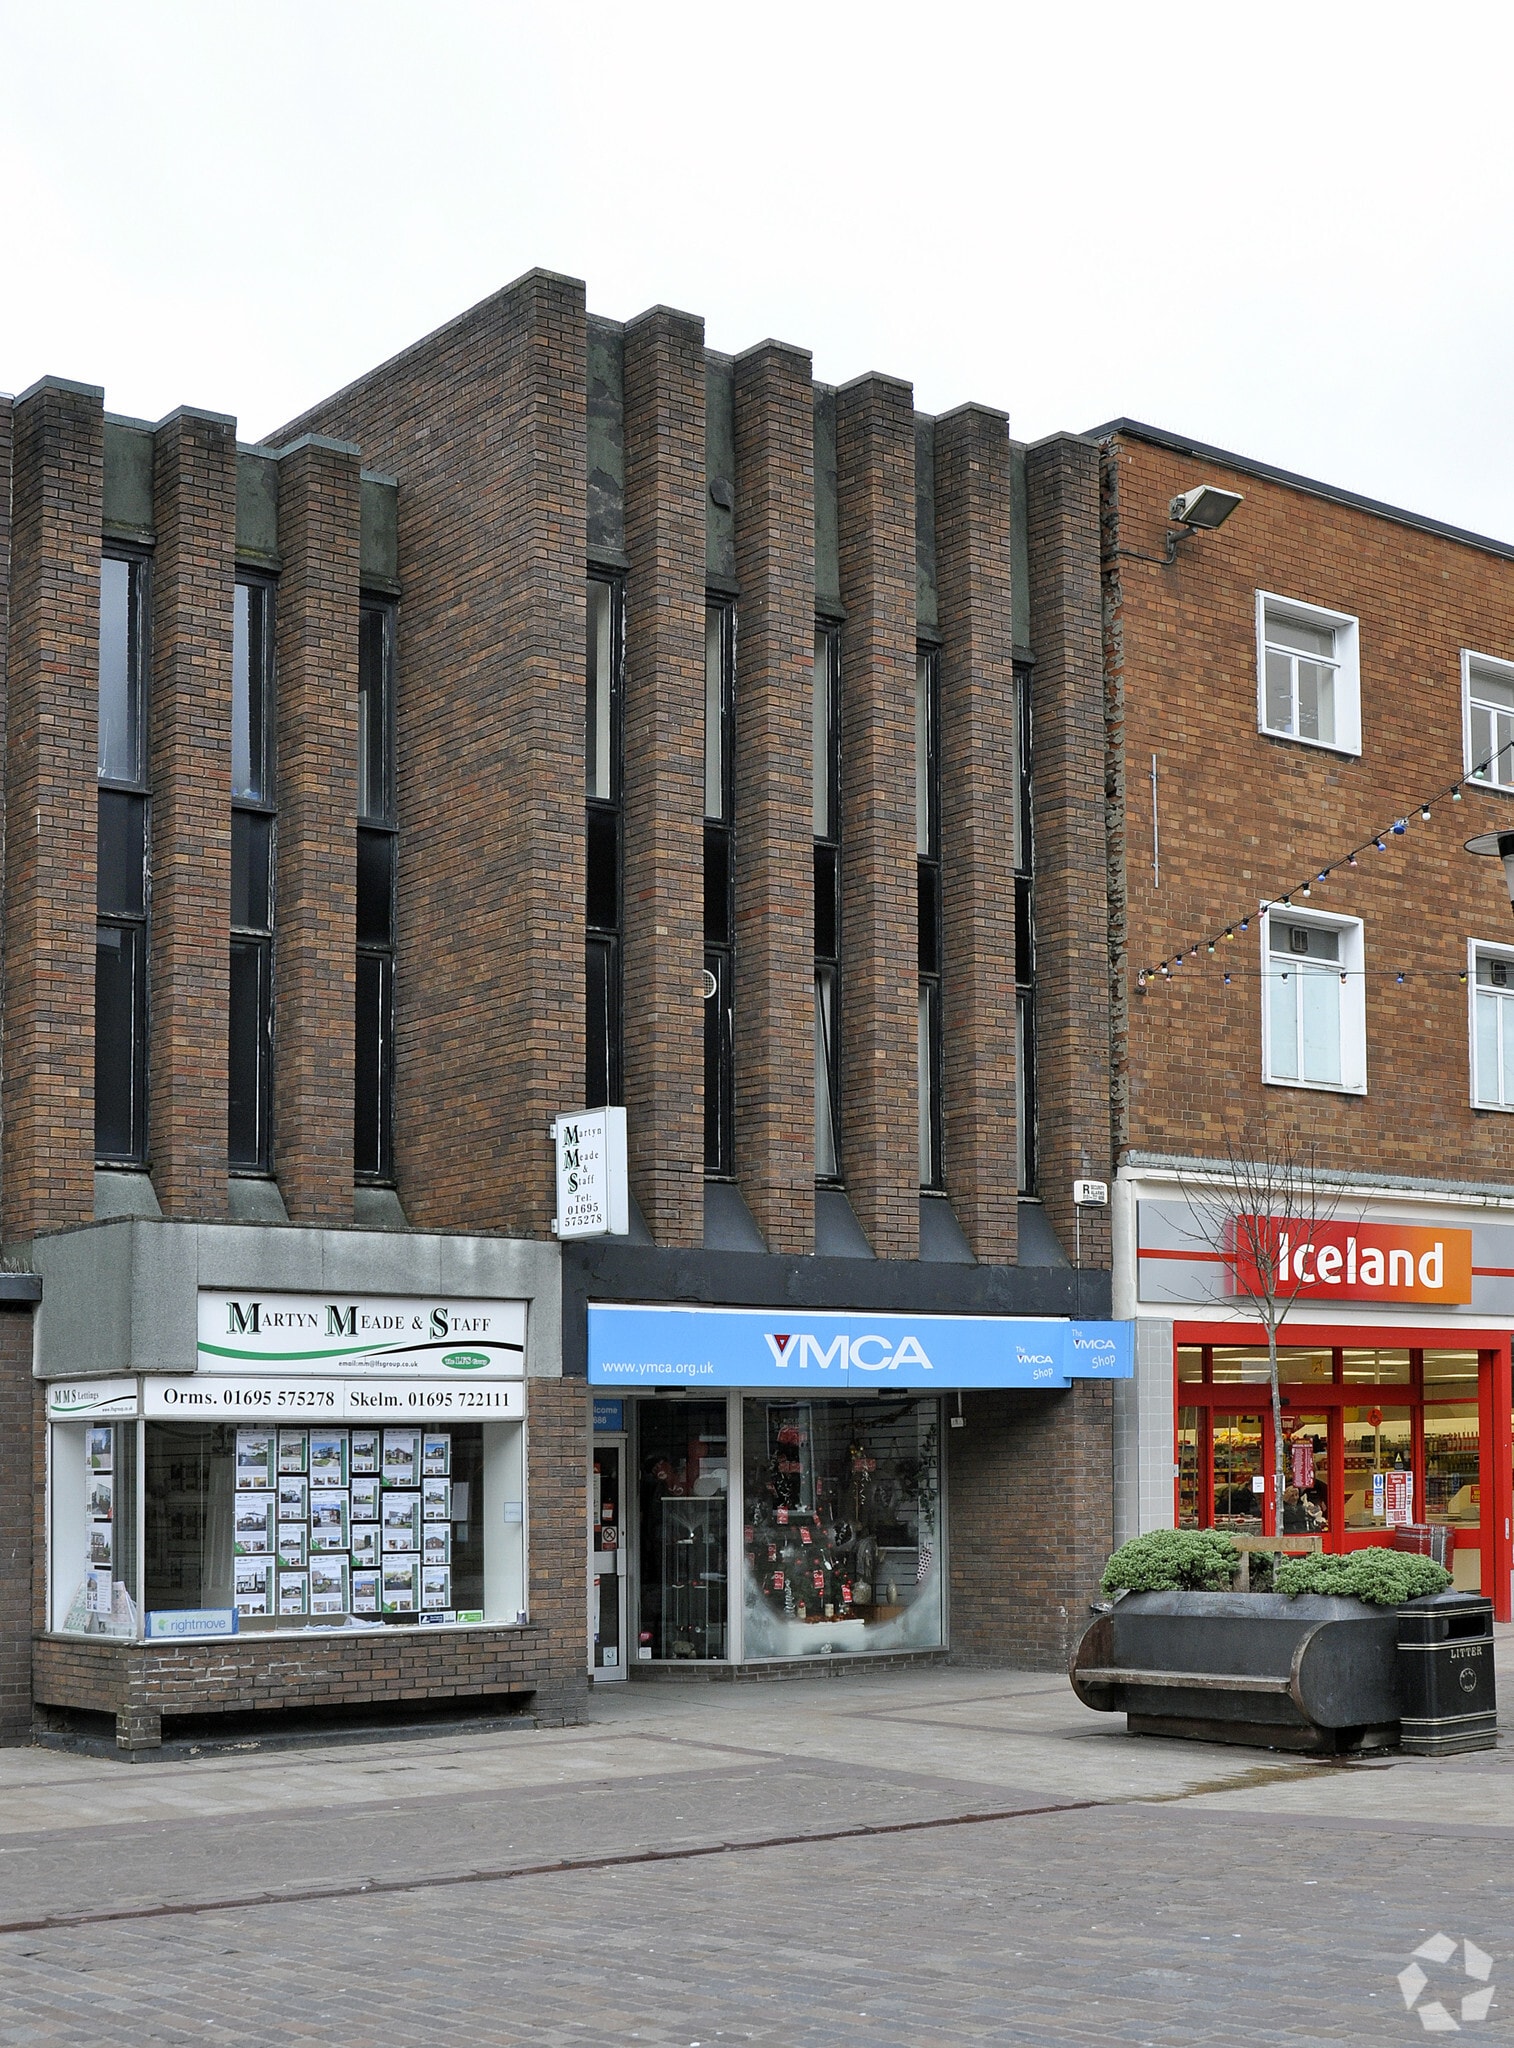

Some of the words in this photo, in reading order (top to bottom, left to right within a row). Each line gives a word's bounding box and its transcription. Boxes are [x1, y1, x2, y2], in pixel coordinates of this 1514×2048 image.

[562, 1125, 602, 1148] Martyn
[562, 1148, 599, 1171] Meade
[582, 1164, 588, 1173] &
[567, 1172, 594, 1195] Staff
[1082, 1184, 1090, 1194] R
[575, 1194, 592, 1203] Tel:
[567, 1202, 599, 1216] 01695
[564, 1213, 602, 1228] 575278
[1279, 1232, 1444, 1289] Iceland
[411, 1315, 423, 1330] &
[1072, 1329, 1083, 1337] The
[1016, 1346, 1026, 1354] The
[1073, 1339, 1116, 1350] YMCA
[764, 1334, 934, 1371] YMCA
[1017, 1355, 1054, 1364] YMCA
[1092, 1354, 1116, 1369] Shop
[602, 1361, 714, 1377] www.ymca.org.uk
[1033, 1367, 1054, 1380] Shop
[78, 1390, 99, 1401] Lettings
[164, 1388, 217, 1404] Orms.
[223, 1389, 272, 1405] 01695
[277, 1391, 335, 1407] 575278
[350, 1391, 403, 1407] Skelm.
[408, 1391, 454, 1407] 01695
[458, 1392, 510, 1407] 722111
[171, 1619, 226, 1633] rightmove
[1450, 1646, 1482, 1659] LITTER
